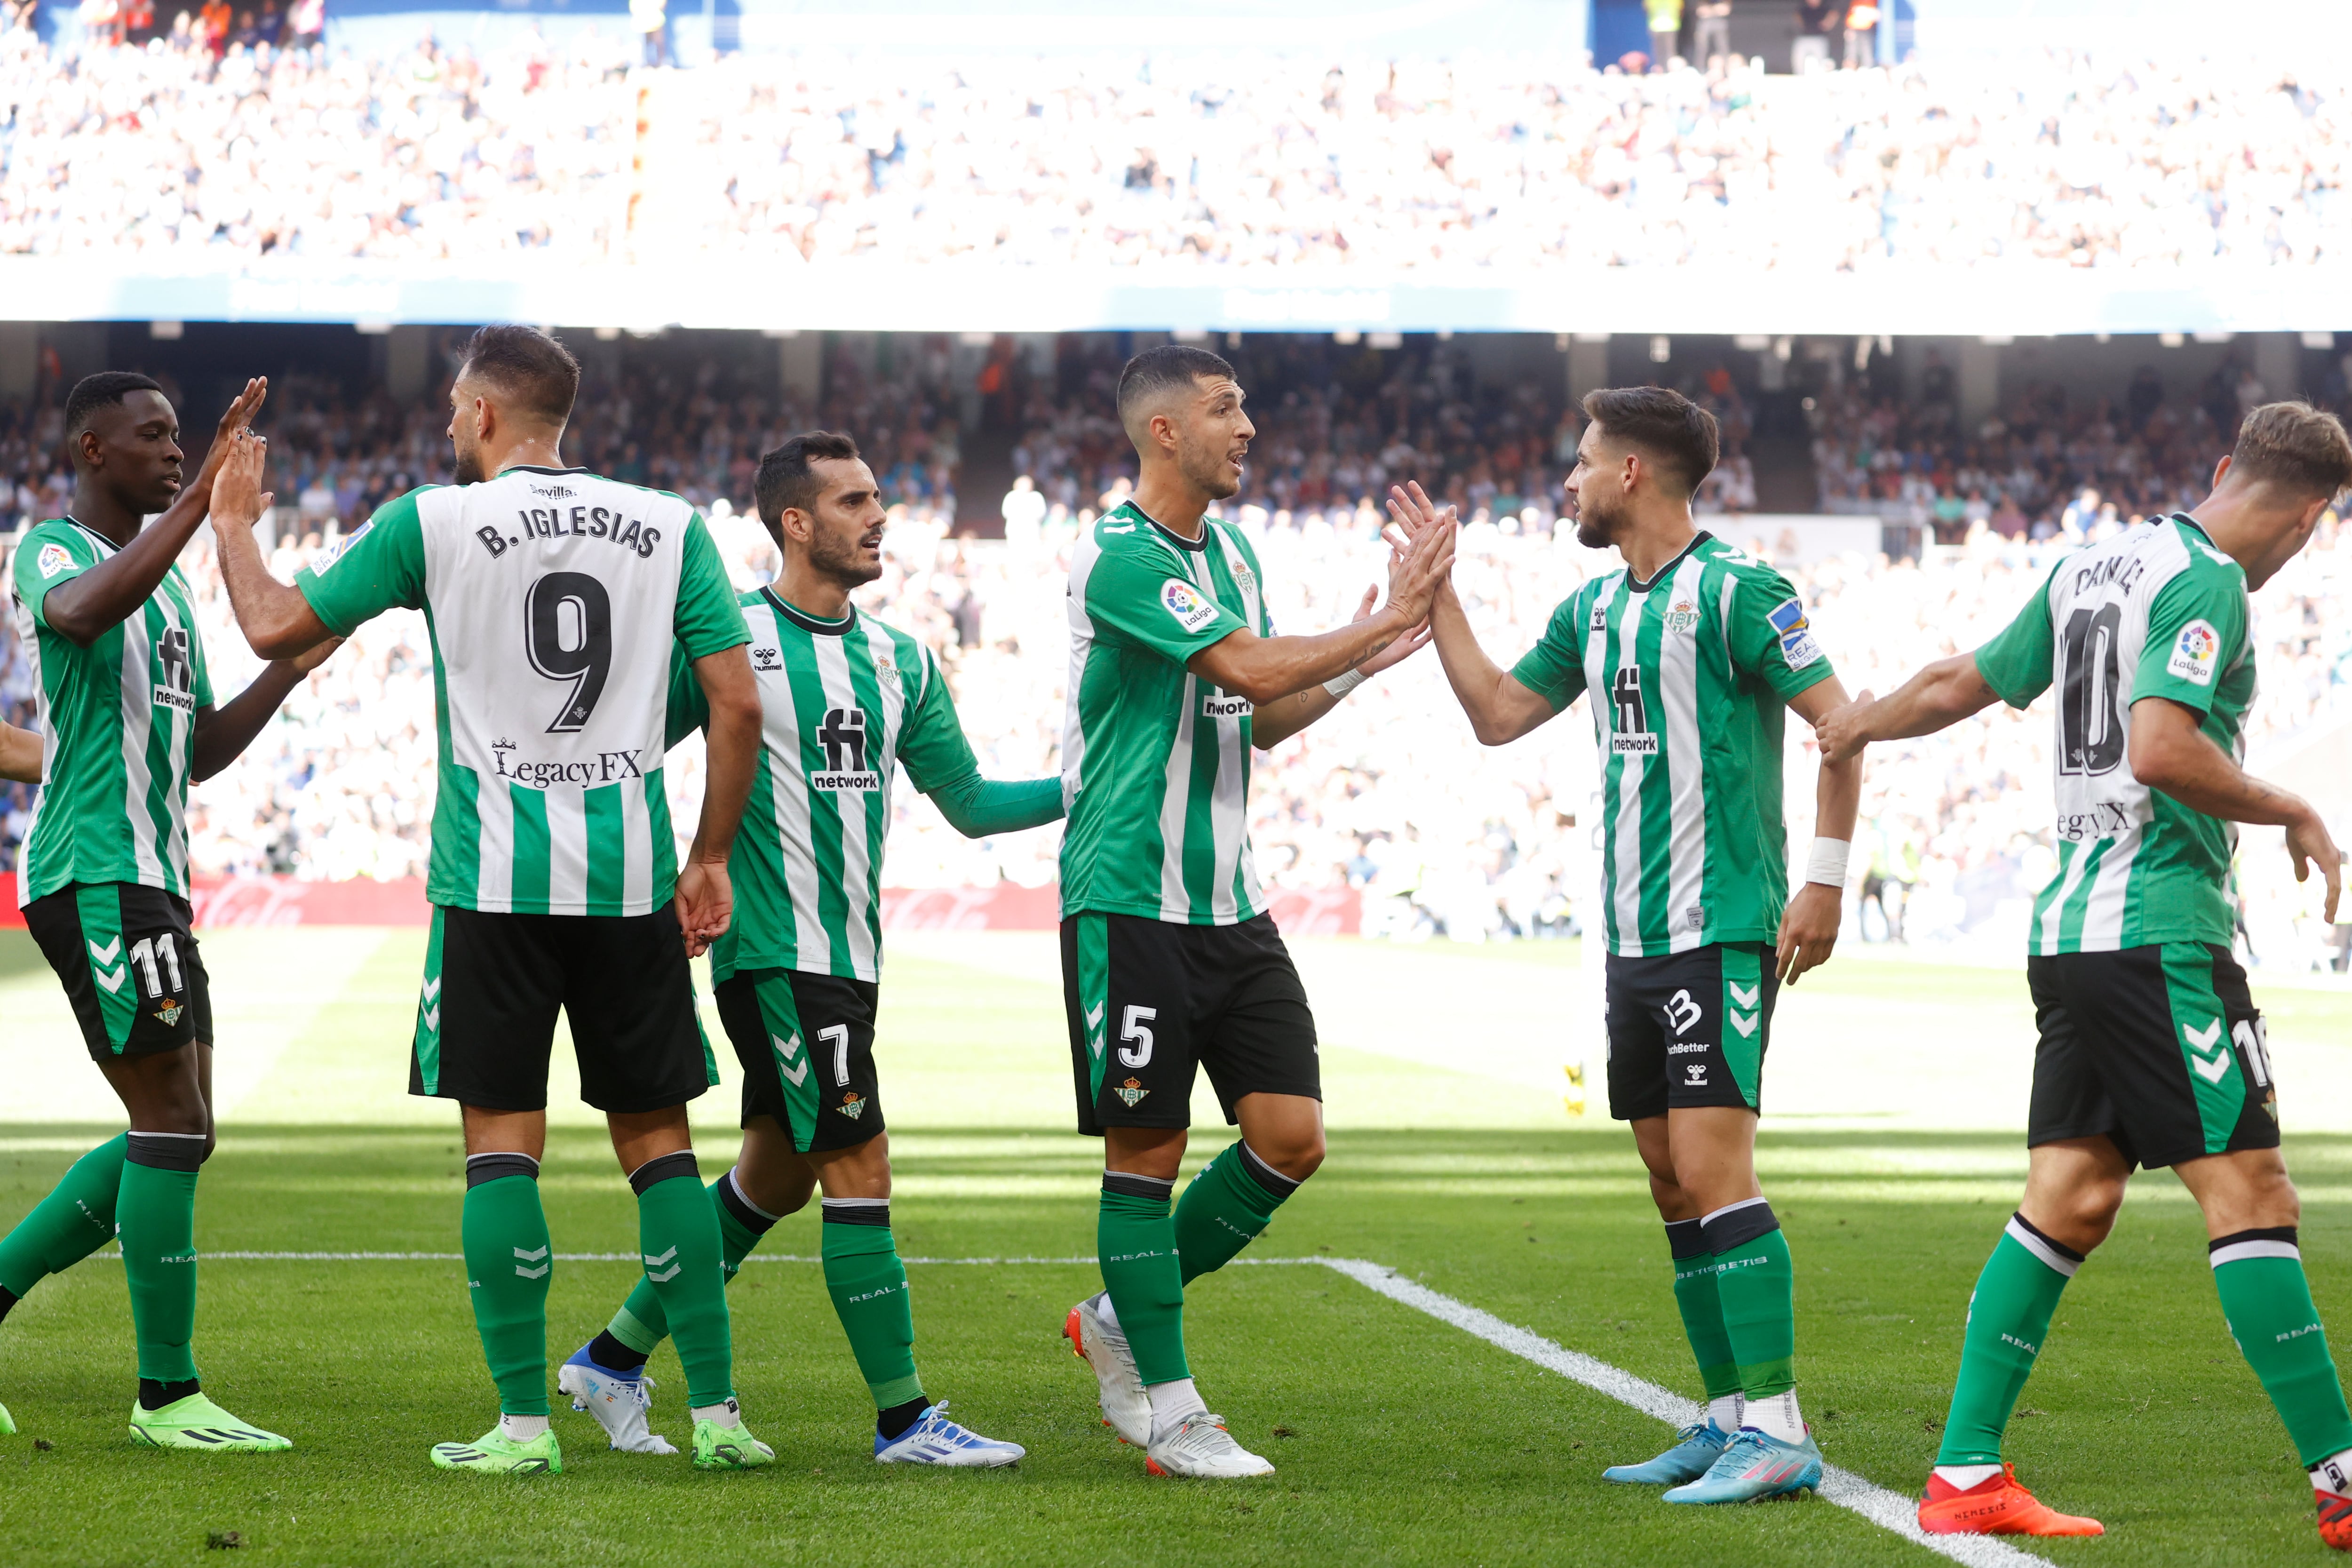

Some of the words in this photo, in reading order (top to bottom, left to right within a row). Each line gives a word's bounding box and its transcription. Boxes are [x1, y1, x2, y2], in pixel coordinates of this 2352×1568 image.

[476, 525, 519, 558] B.
[518, 506, 661, 558] IGLESIAS
[1185, 607, 1212, 626] LaLiga
[524, 572, 612, 733] 9
[1788, 638, 1816, 661] REAL
[2174, 659, 2207, 676] LaLiga
[2058, 603, 2124, 777] 10
[156, 691, 193, 710] network
[1207, 700, 1251, 715] nwork
[1614, 669, 1645, 733] fi
[819, 709, 866, 771] fi
[1614, 736, 1655, 750] network
[815, 774, 877, 788] network
[130, 932, 183, 998] 11
[1118, 1005, 1157, 1068] 5
[817, 1024, 850, 1087] 7
[1111, 1250, 1163, 1262] REAL
[1718, 1256, 1768, 1272] BETIS
[1677, 1265, 1717, 1280] BETIS
[849, 1287, 896, 1304] REAL
[2000, 1333, 2036, 1355] REAL
[1955, 1503, 2006, 1520] NEMESIS
